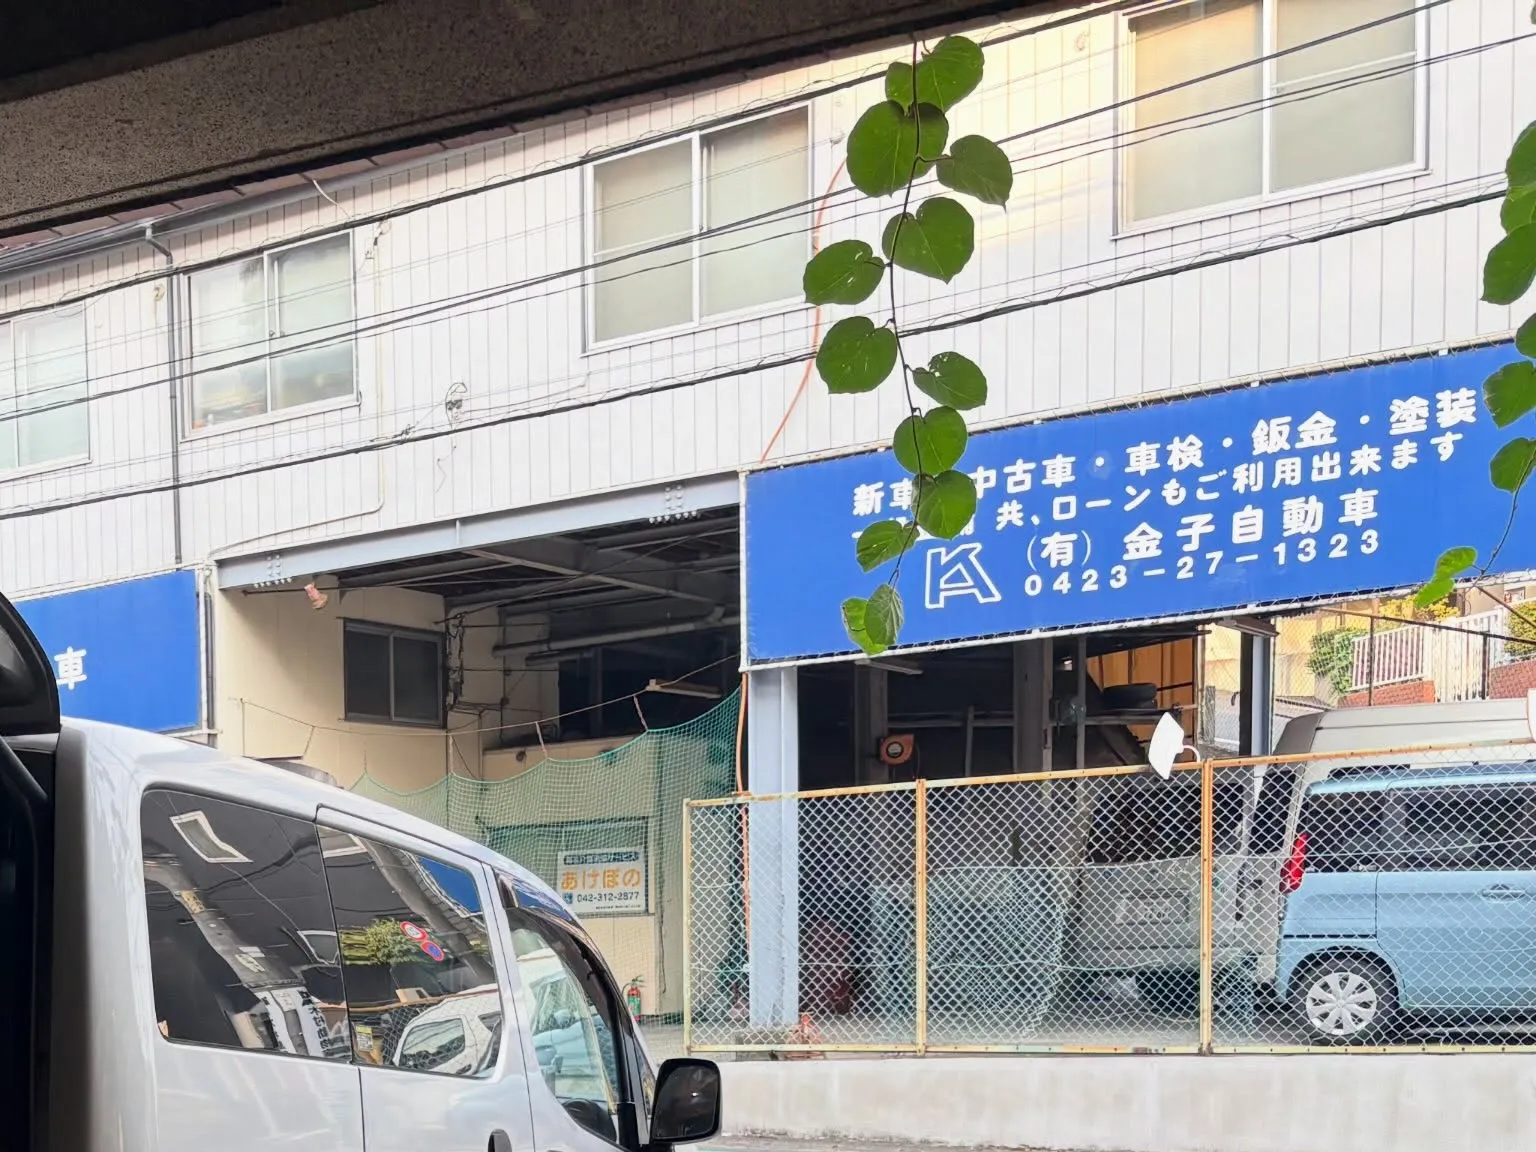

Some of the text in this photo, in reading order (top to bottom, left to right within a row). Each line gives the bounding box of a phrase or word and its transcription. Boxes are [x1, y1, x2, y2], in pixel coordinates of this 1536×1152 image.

[1122, 487, 1380, 561] 金子自動車
[1024, 529, 1380, 597] 0423-27-1323
[561, 868, 641, 890] あけぼの
